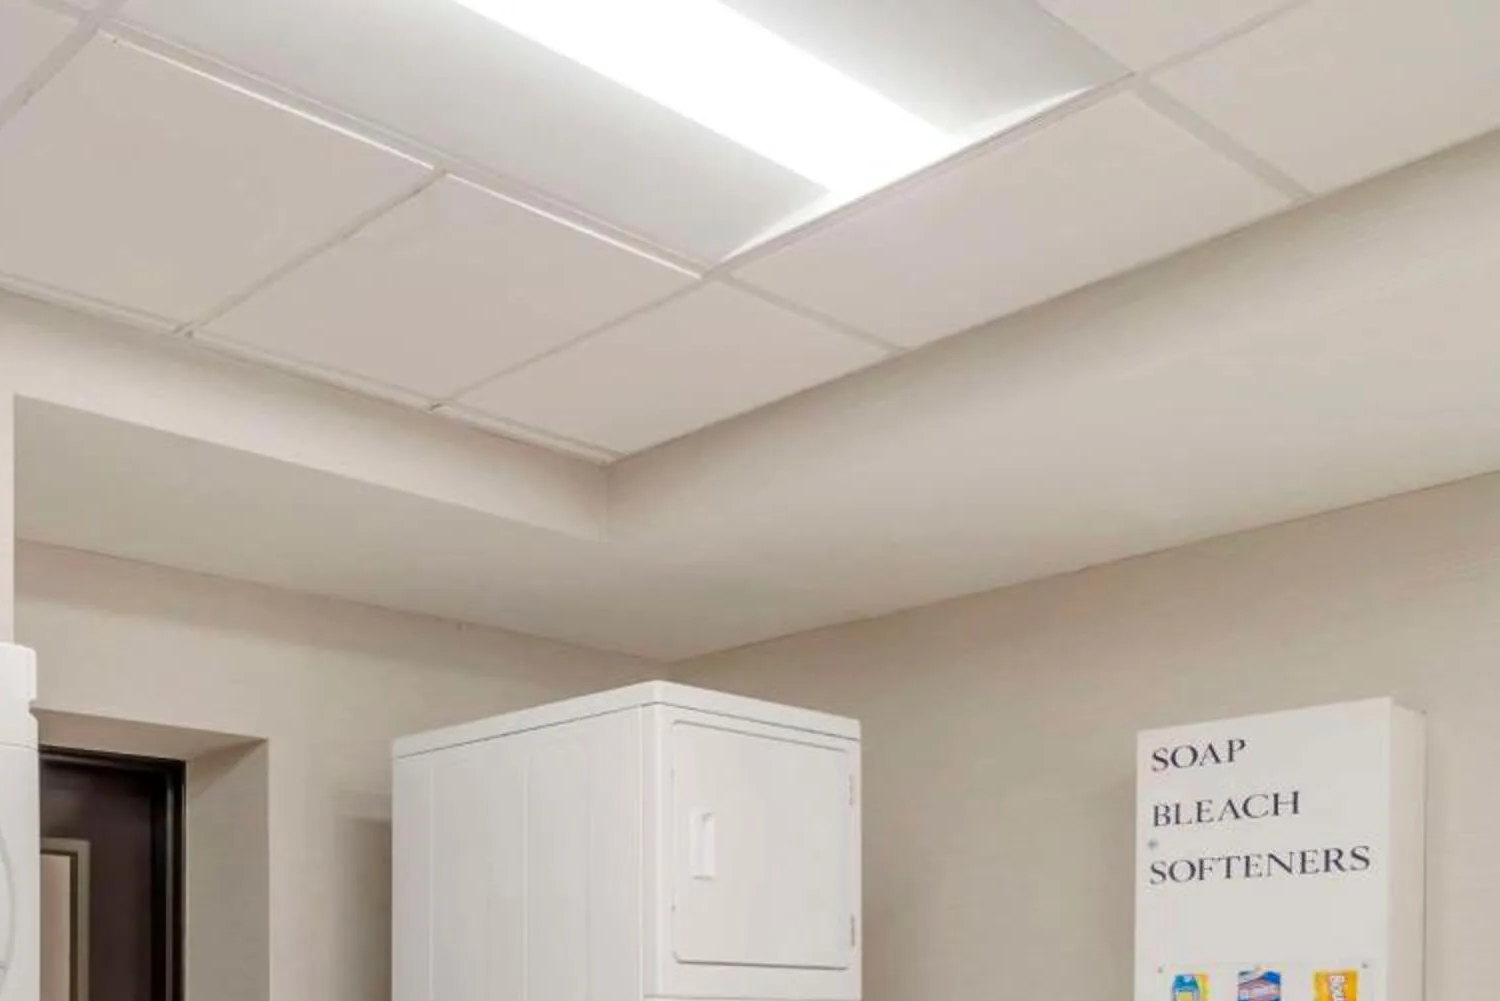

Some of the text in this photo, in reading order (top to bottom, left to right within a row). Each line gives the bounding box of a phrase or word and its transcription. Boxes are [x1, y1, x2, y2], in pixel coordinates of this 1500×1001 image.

[1151, 738, 1247, 773] SOAP
[1152, 790, 1300, 828] BLEACH
[1149, 845, 1372, 886] SOFTENERS
